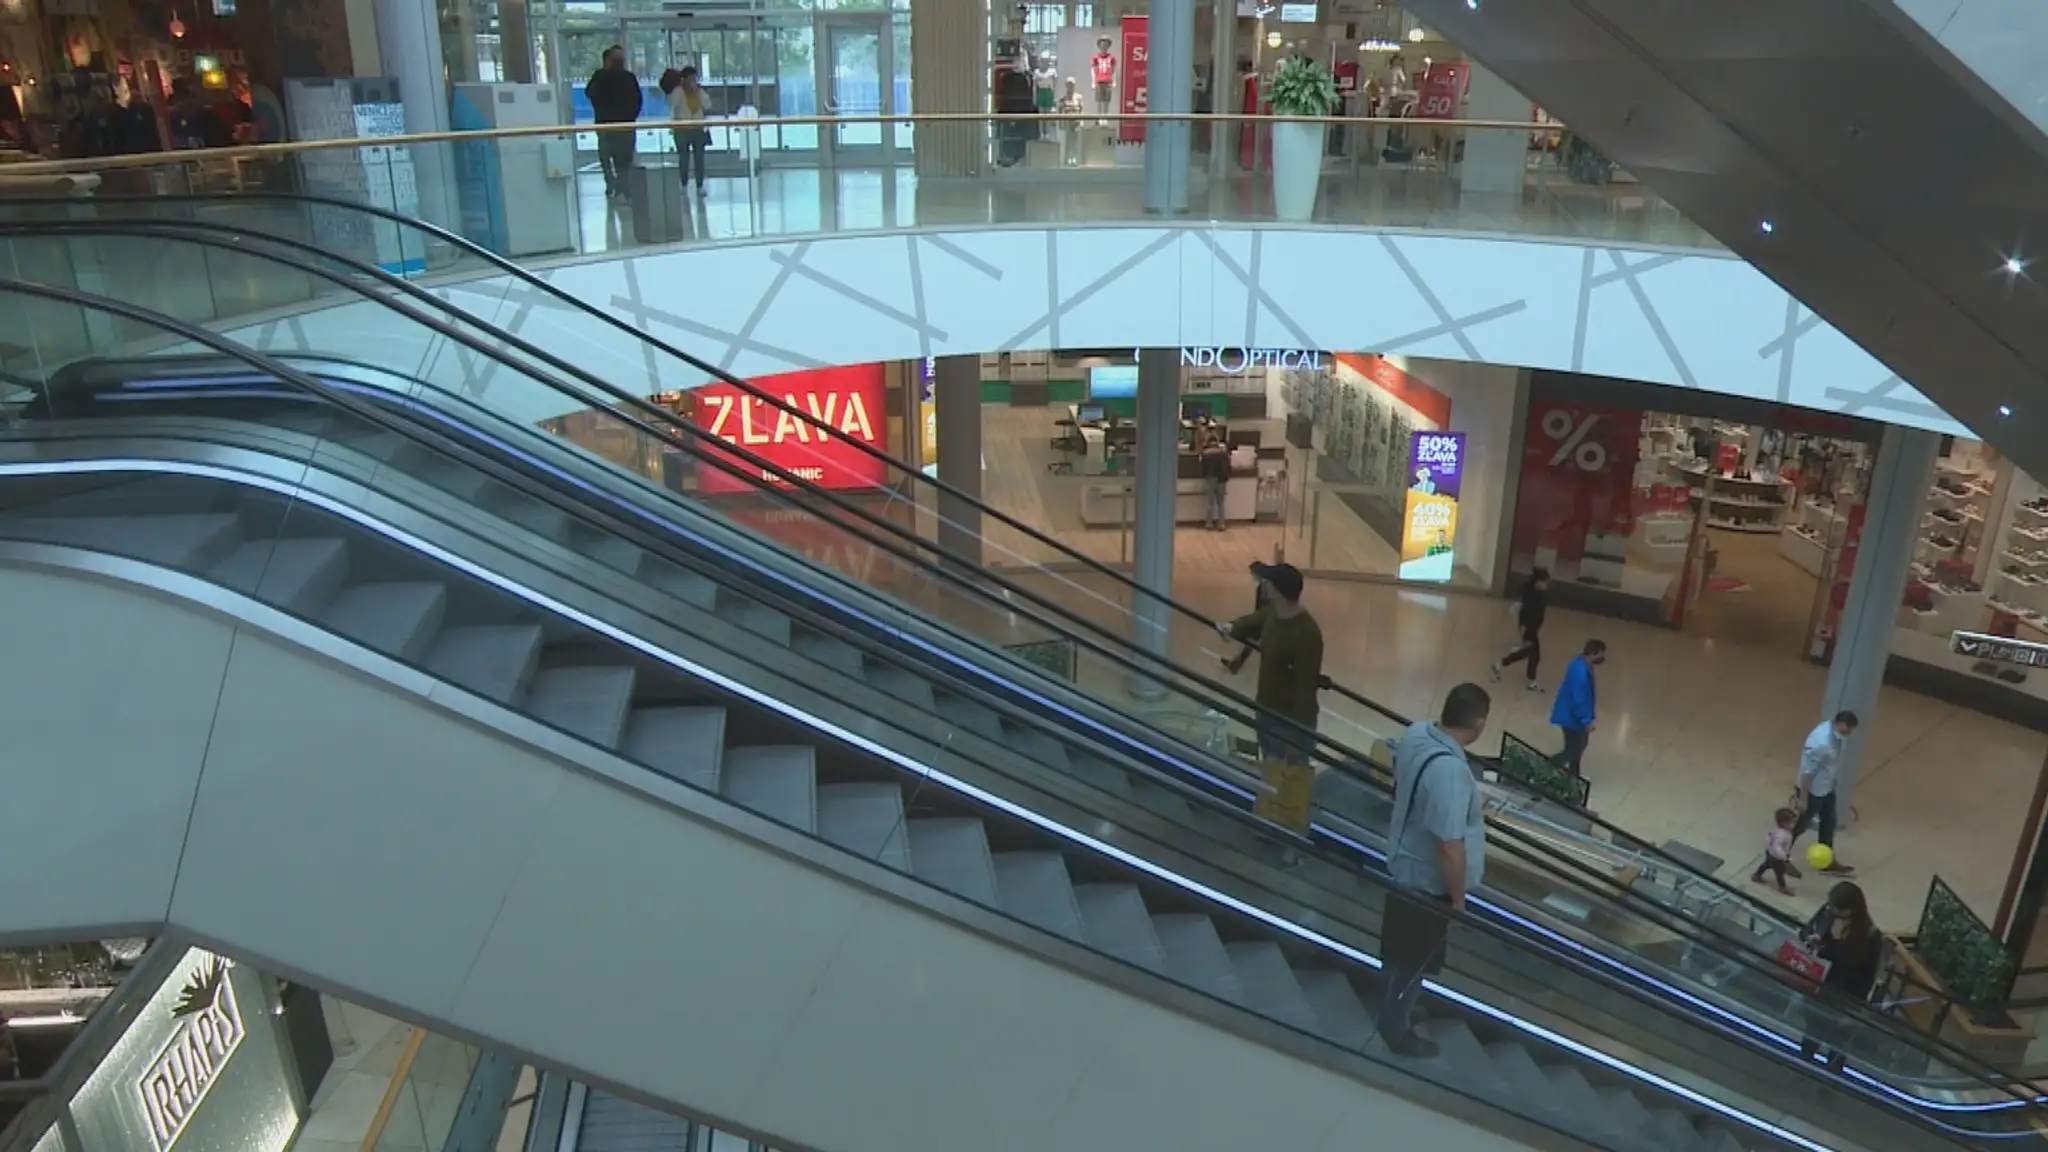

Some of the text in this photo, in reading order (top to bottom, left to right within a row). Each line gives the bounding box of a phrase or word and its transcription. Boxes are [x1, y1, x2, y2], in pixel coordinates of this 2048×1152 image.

[1134, 346, 1324, 373] NDOPTICAL
[1418, 437, 1458, 452] 50%
[149, 983, 234, 1141] RHAPIS
